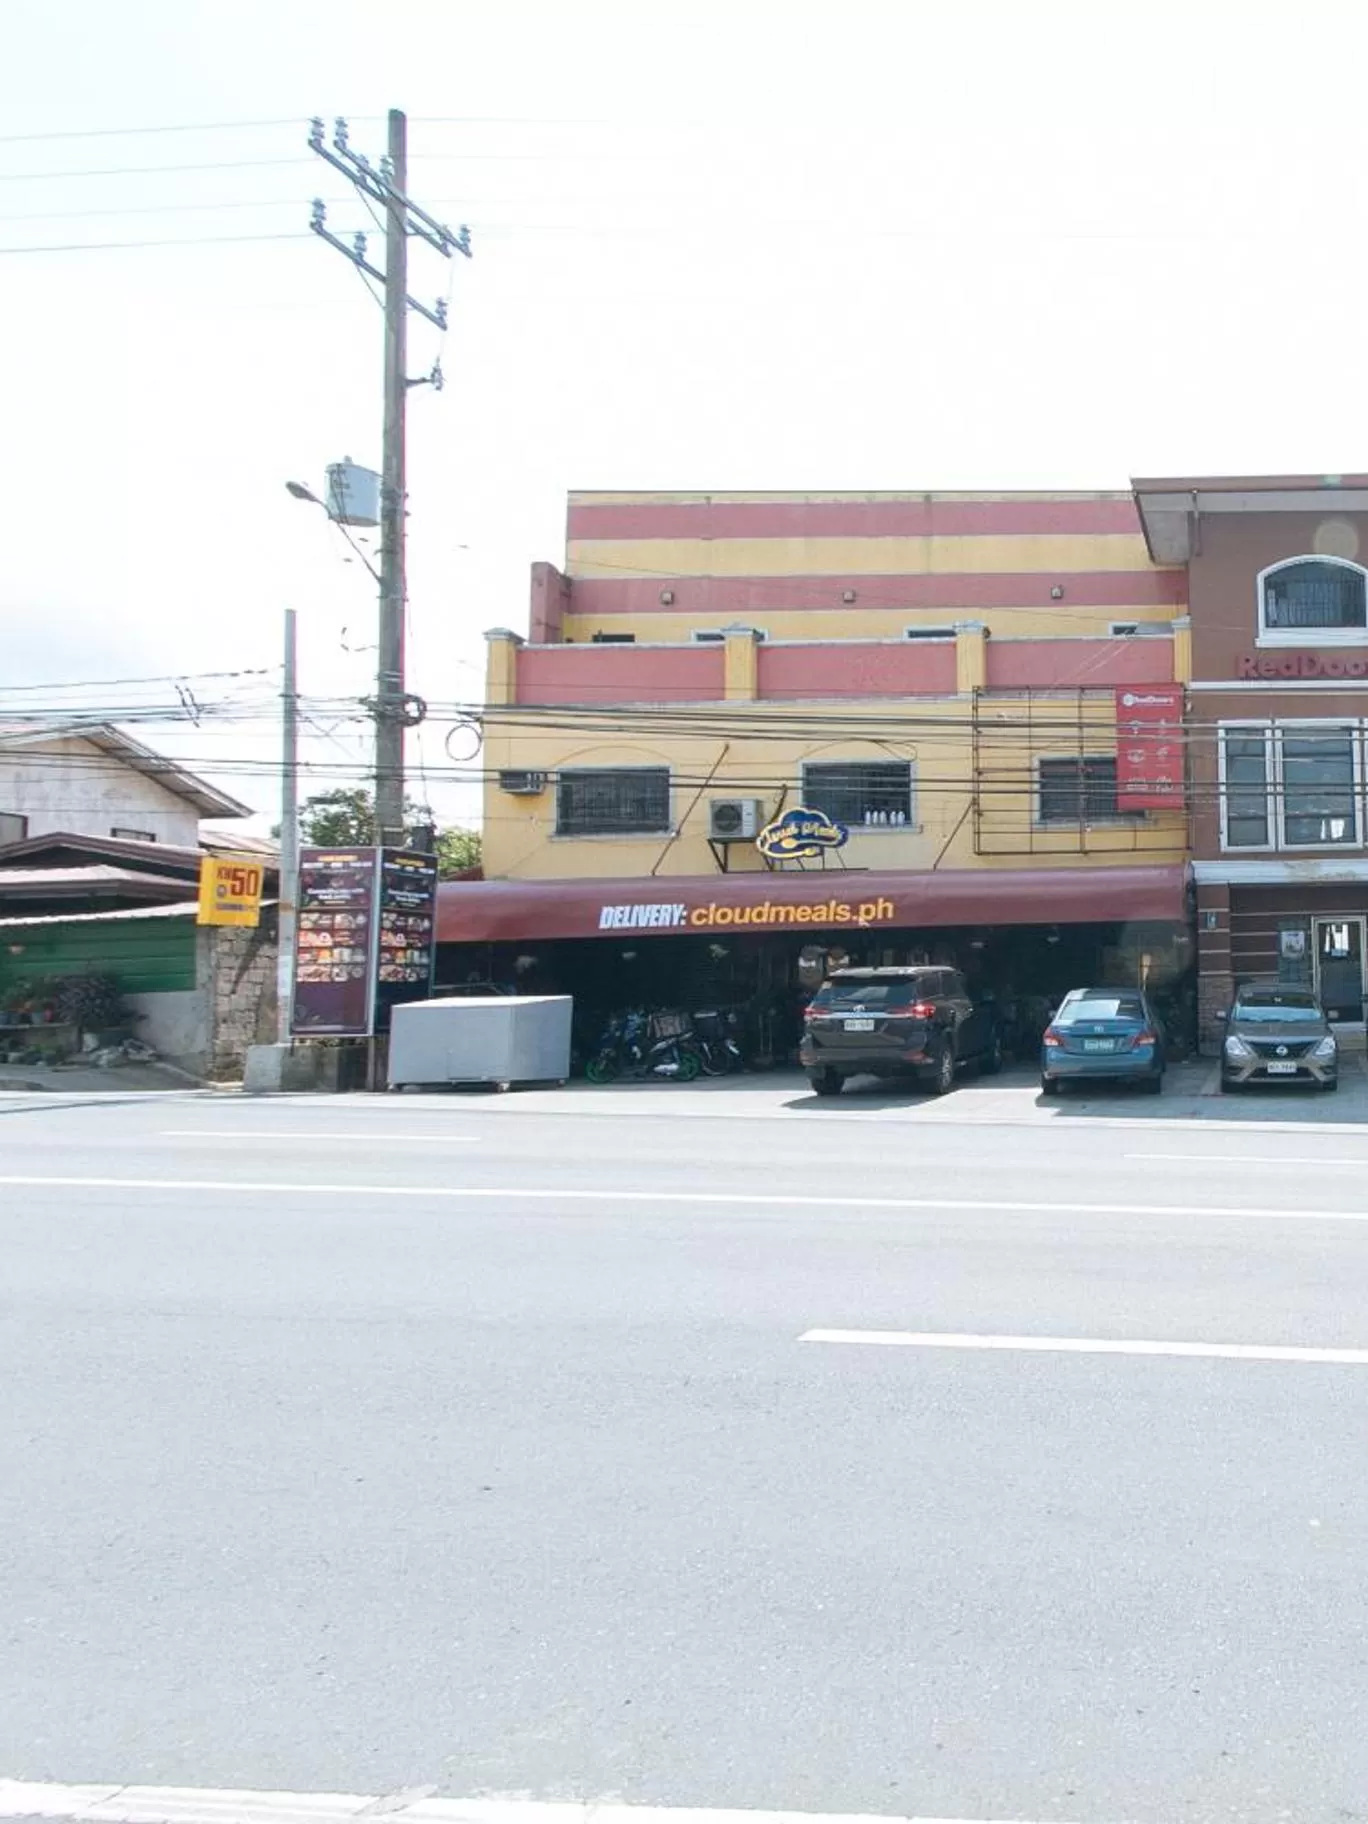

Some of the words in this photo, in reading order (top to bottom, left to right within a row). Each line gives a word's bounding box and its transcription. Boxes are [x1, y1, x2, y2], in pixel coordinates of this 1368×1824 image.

[231, 867, 259, 896] 50
[599, 904, 687, 929] DELIVERY:
[691, 897, 894, 926] cloudmeals.ph
